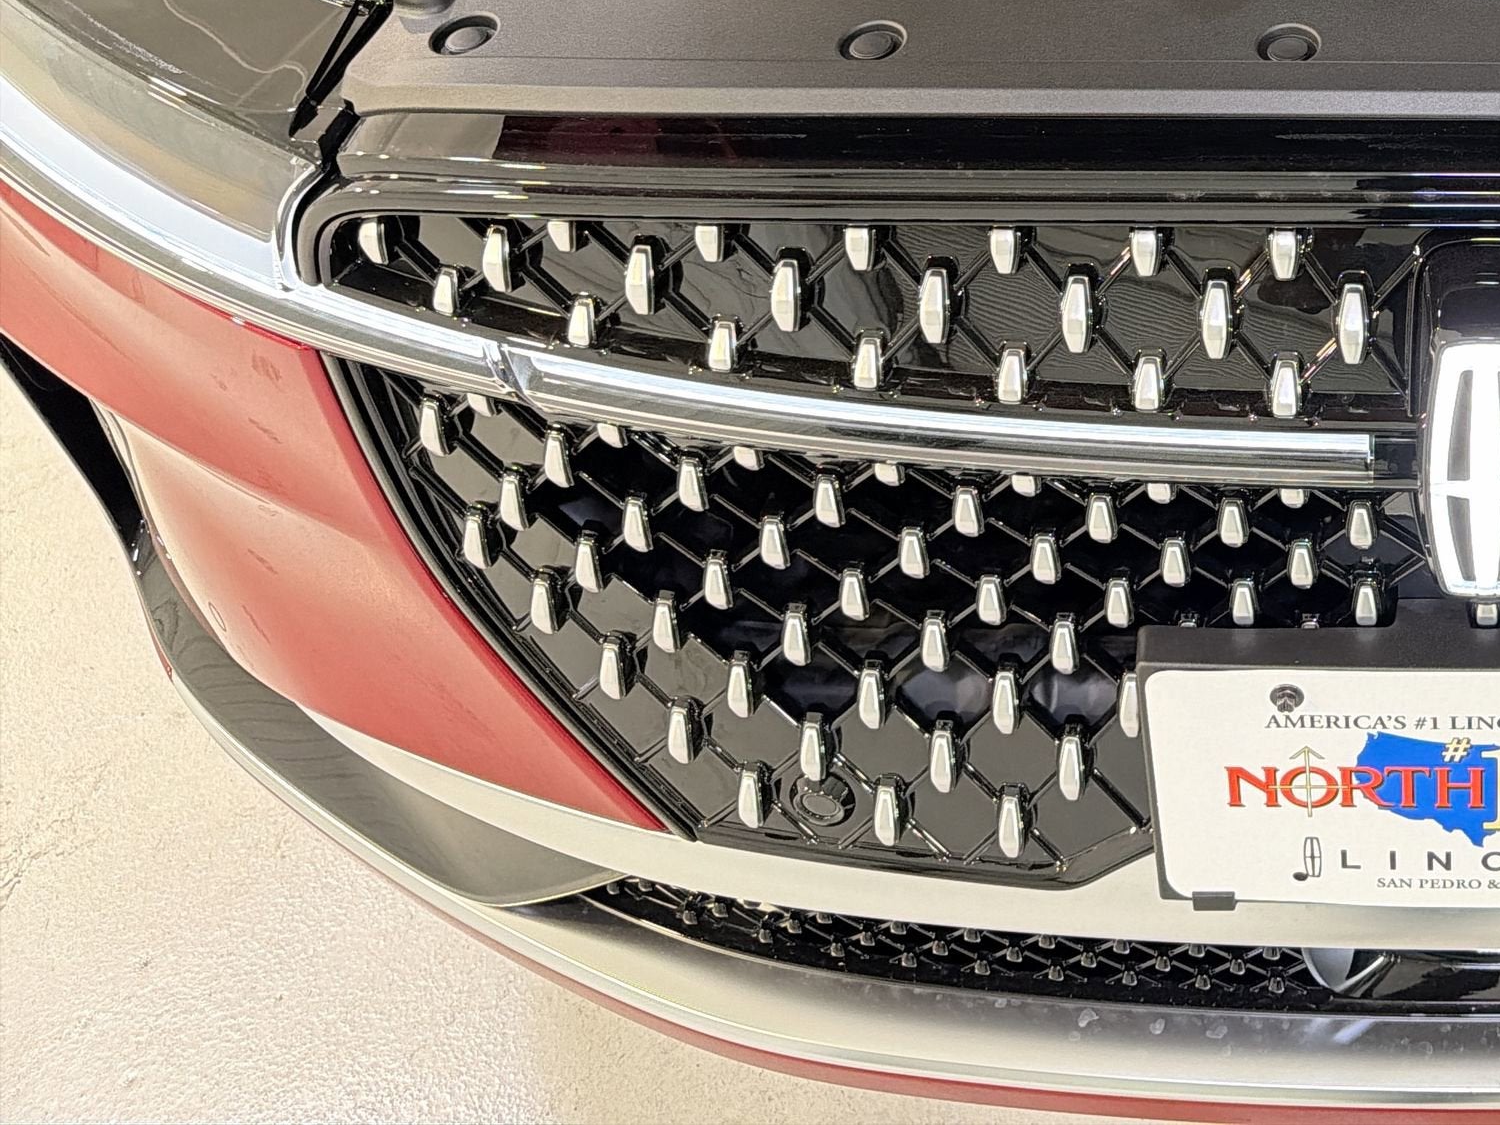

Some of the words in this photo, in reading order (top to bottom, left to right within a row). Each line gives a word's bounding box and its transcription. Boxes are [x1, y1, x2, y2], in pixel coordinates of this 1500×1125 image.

[1265, 714, 1407, 731] AMERICA'S
[1413, 716, 1441, 731] #1
[1224, 765, 1486, 809] NORTH
[1376, 877, 1413, 890] SAN
[1418, 877, 1482, 891] PEDRO
